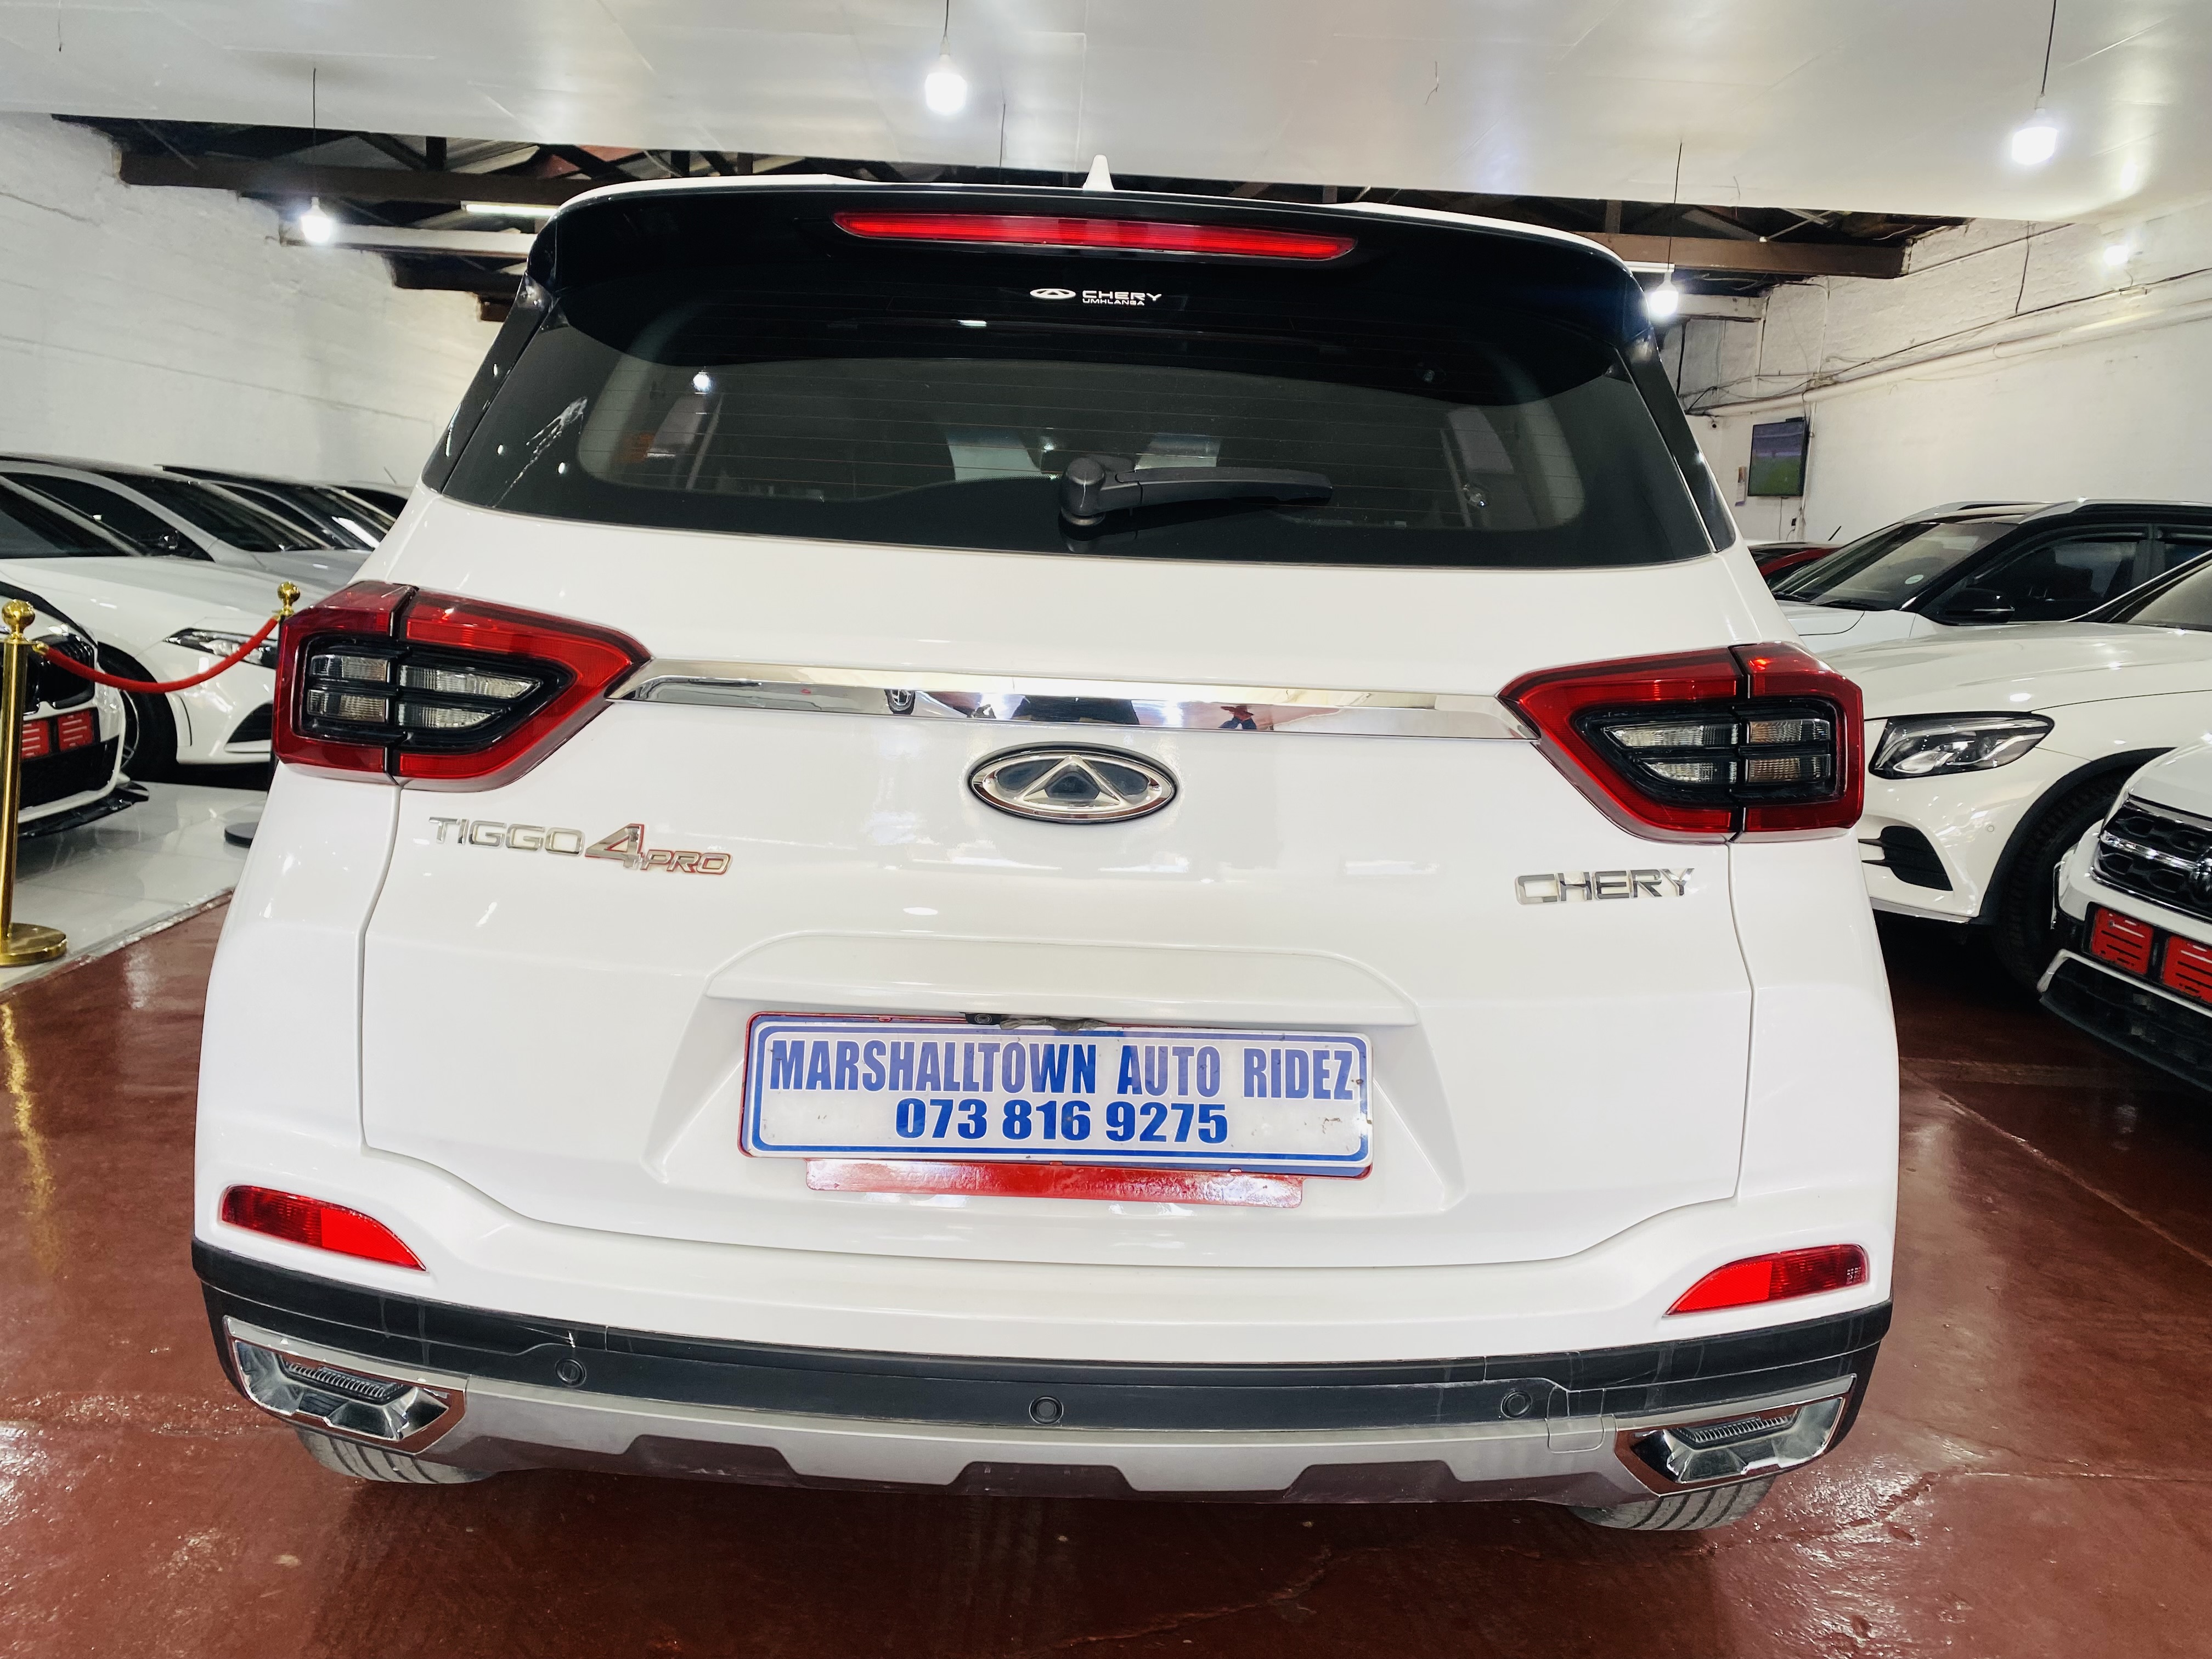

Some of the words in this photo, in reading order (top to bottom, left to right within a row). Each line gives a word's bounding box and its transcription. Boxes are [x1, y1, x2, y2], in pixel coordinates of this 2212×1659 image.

[1082, 290, 1162, 301] CHERY
[1082, 298, 1145, 306] UMHLANGA
[428, 816, 586, 857] TIGGO
[1514, 867, 1695, 905] CHERY
[770, 1040, 1097, 1095] MARSHALLTOWN
[1117, 1045, 1220, 1098] AUTO
[1244, 1048, 1353, 1101] RIDEZ
[895, 1097, 988, 1140] 073
[1001, 1098, 1092, 1142] 816
[1105, 1100, 1228, 1144] 9275
